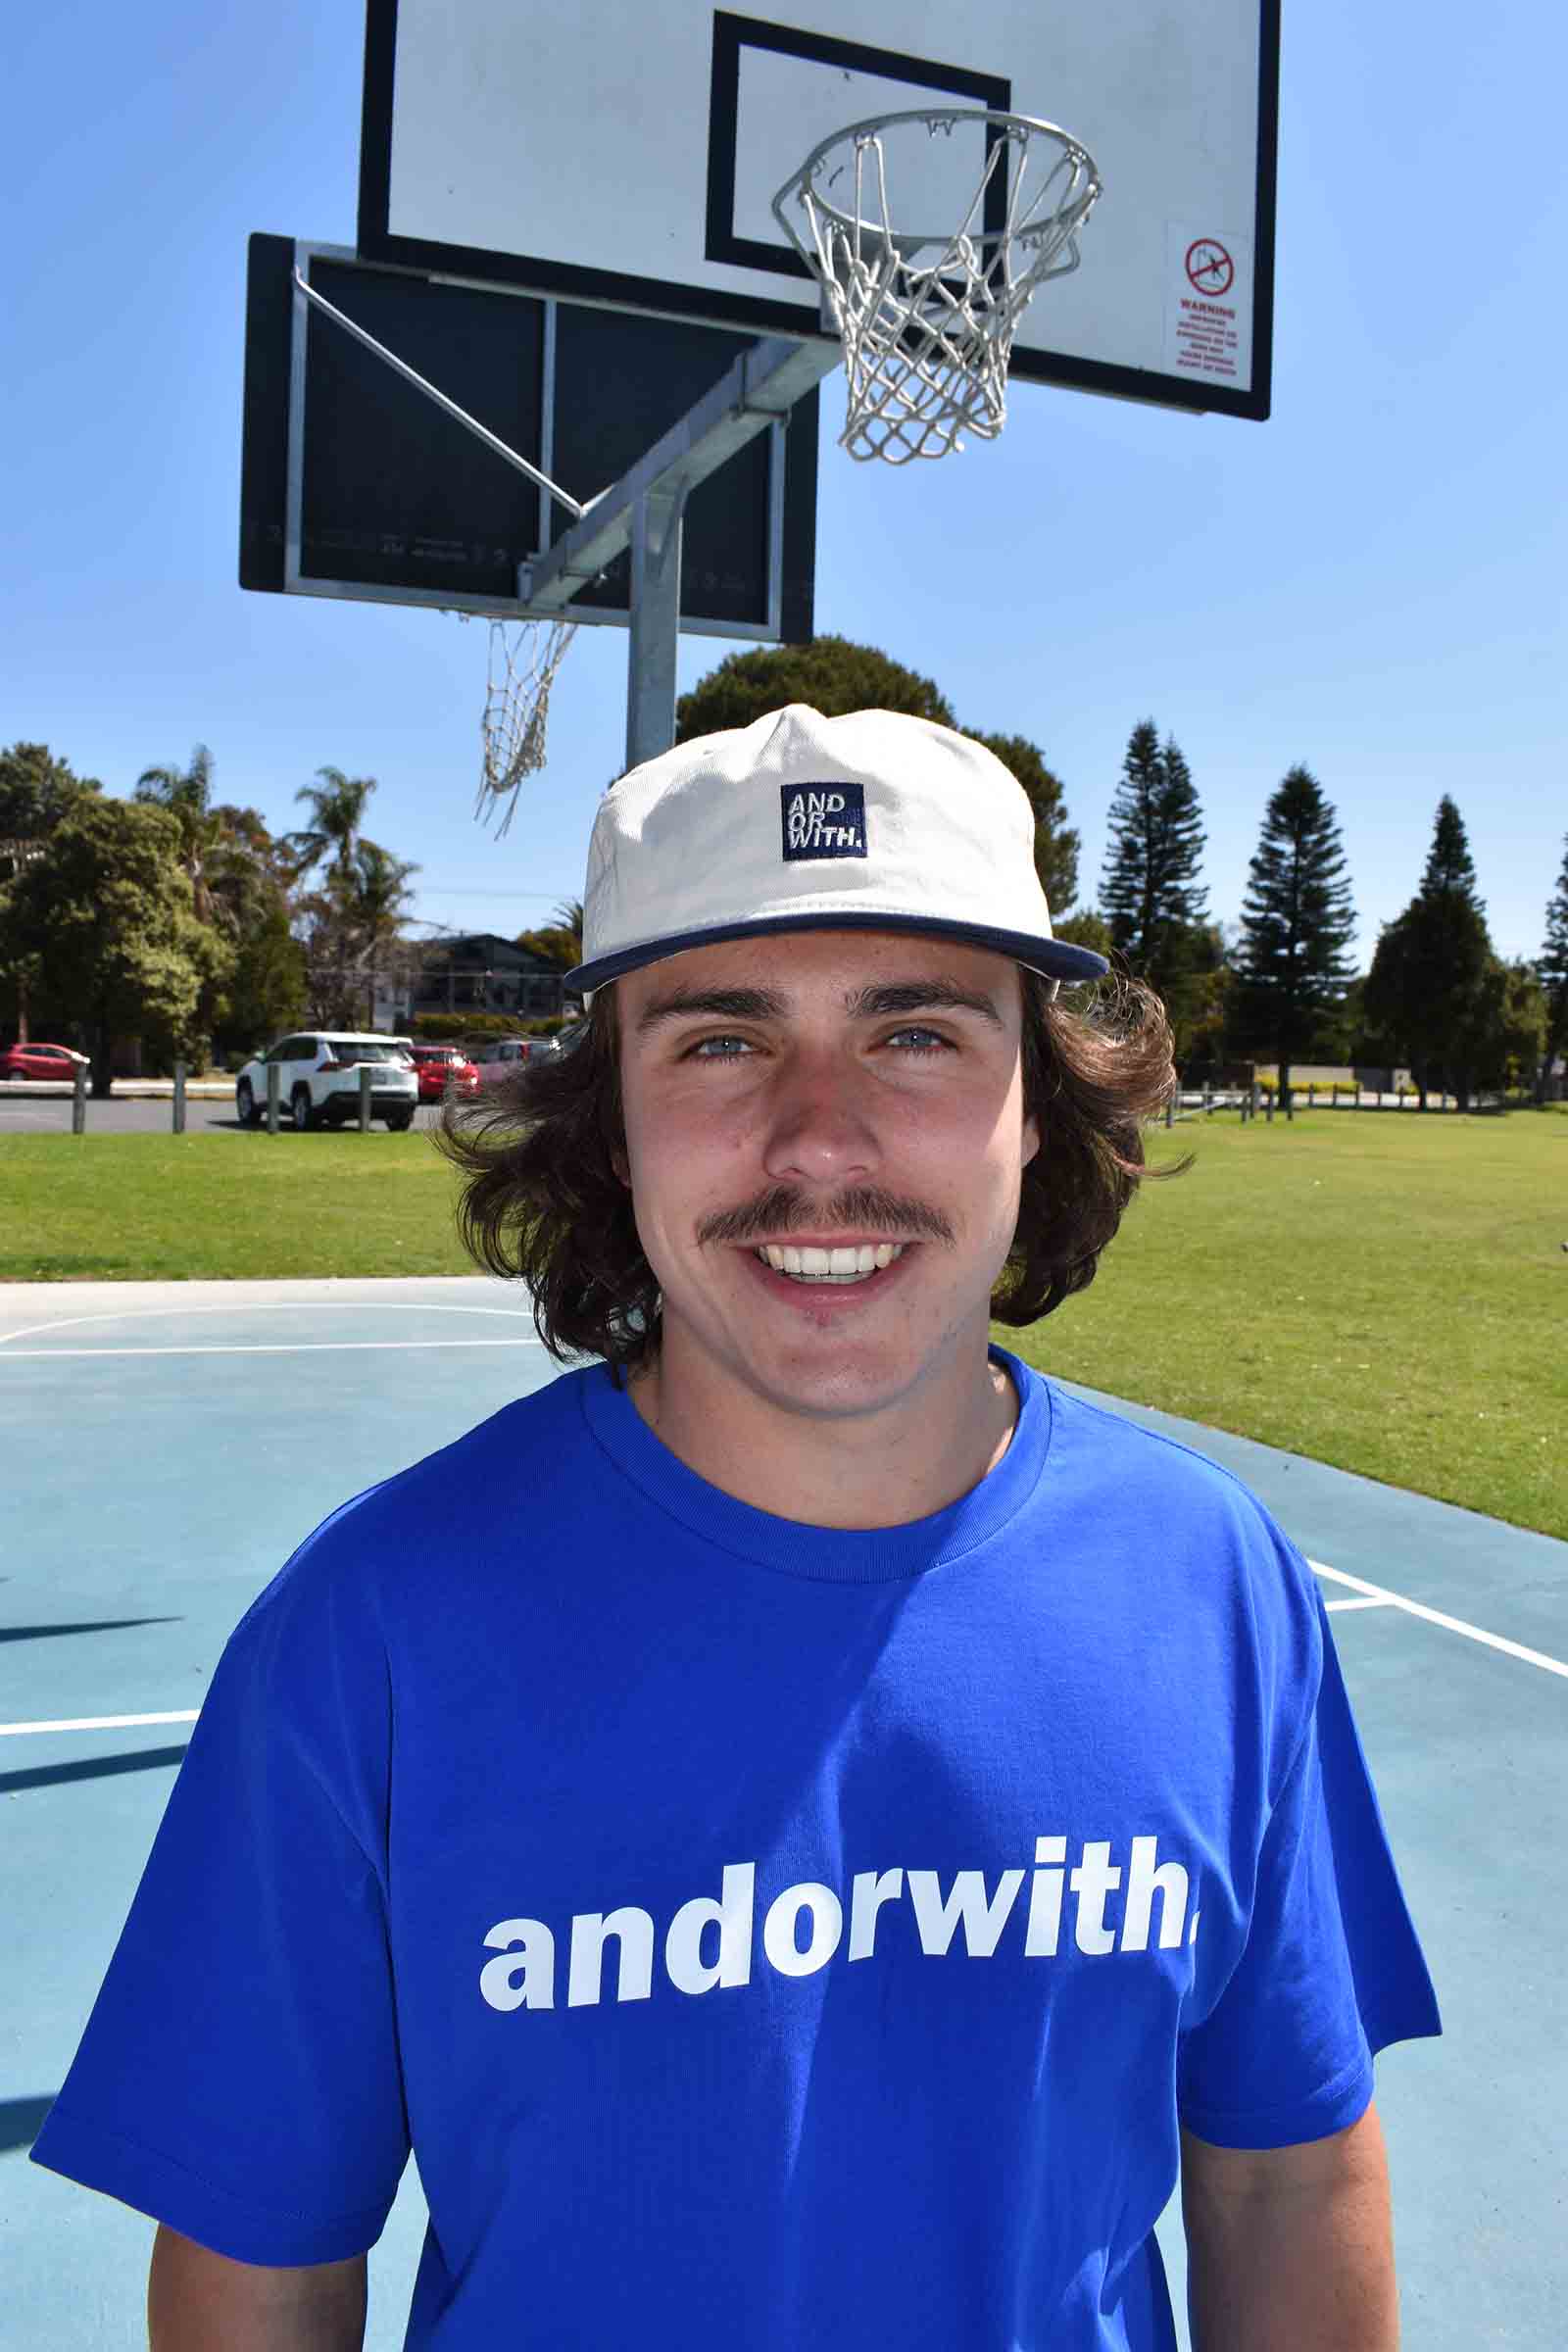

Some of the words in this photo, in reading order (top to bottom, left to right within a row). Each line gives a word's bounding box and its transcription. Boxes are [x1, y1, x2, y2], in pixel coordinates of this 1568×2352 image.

[1180, 298, 1236, 319] WARNING
[789, 793, 846, 813] AND
[788, 811, 826, 832] OR
[787, 827, 862, 849] WITH.
